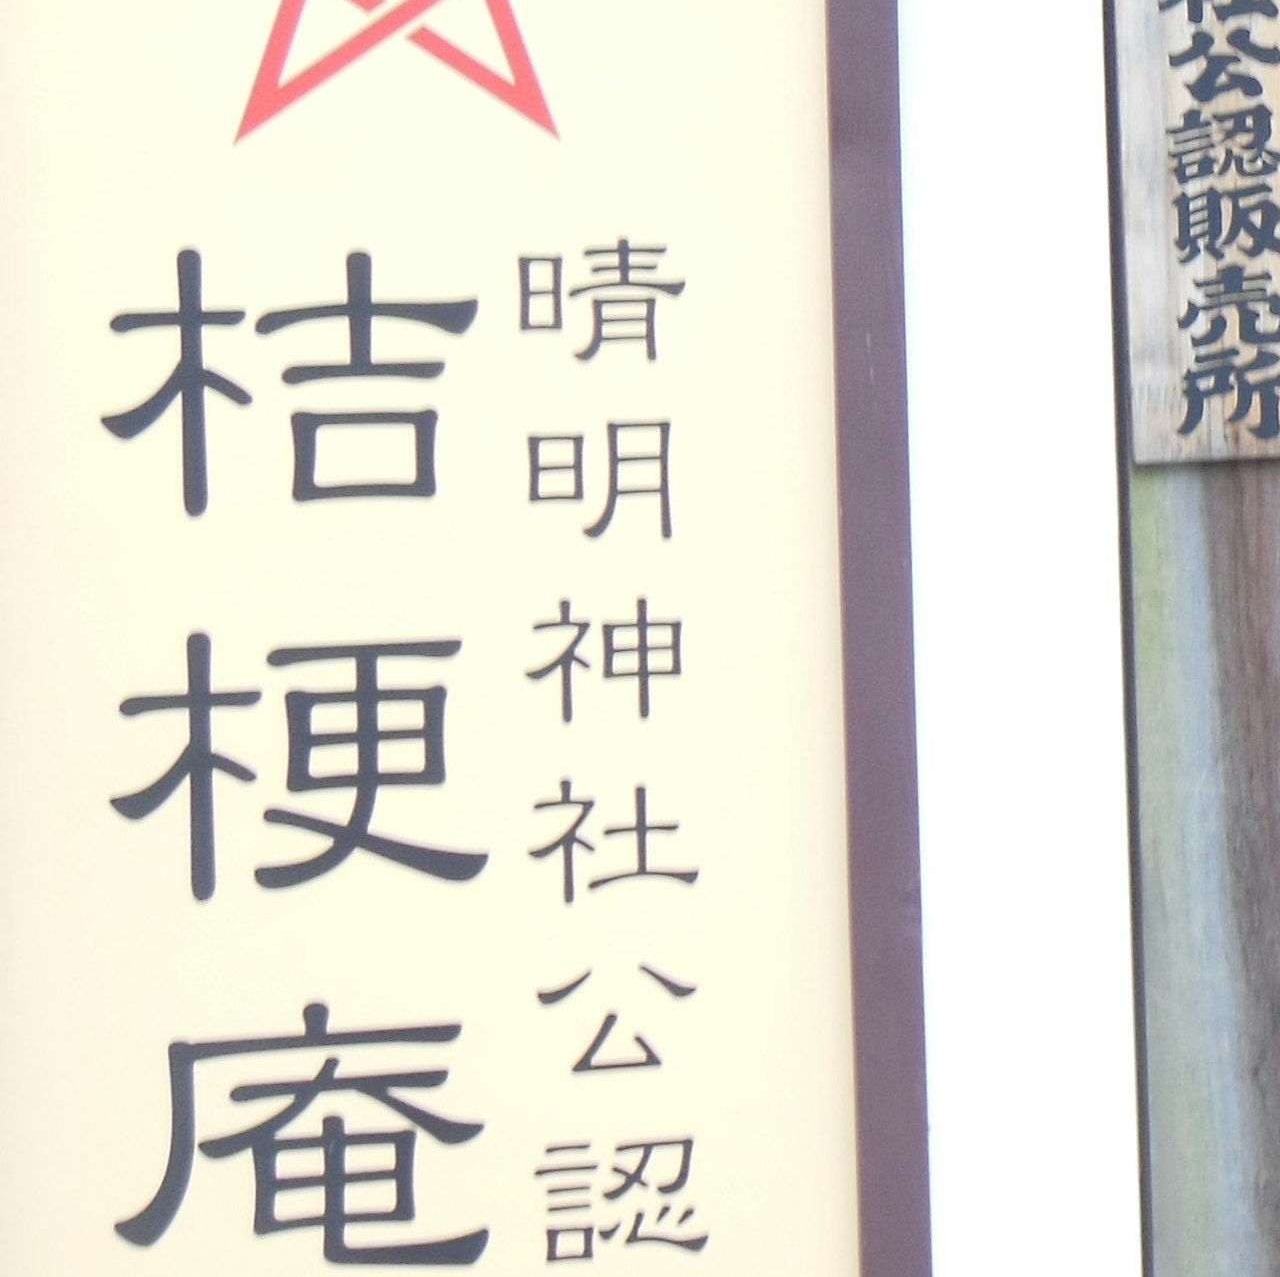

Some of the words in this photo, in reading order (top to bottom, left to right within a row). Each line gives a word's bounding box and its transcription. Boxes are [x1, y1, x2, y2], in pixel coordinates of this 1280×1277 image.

[100, 247, 491, 1267] 桔梗庵
[518, 237, 710, 1263] 晴明神社公認
